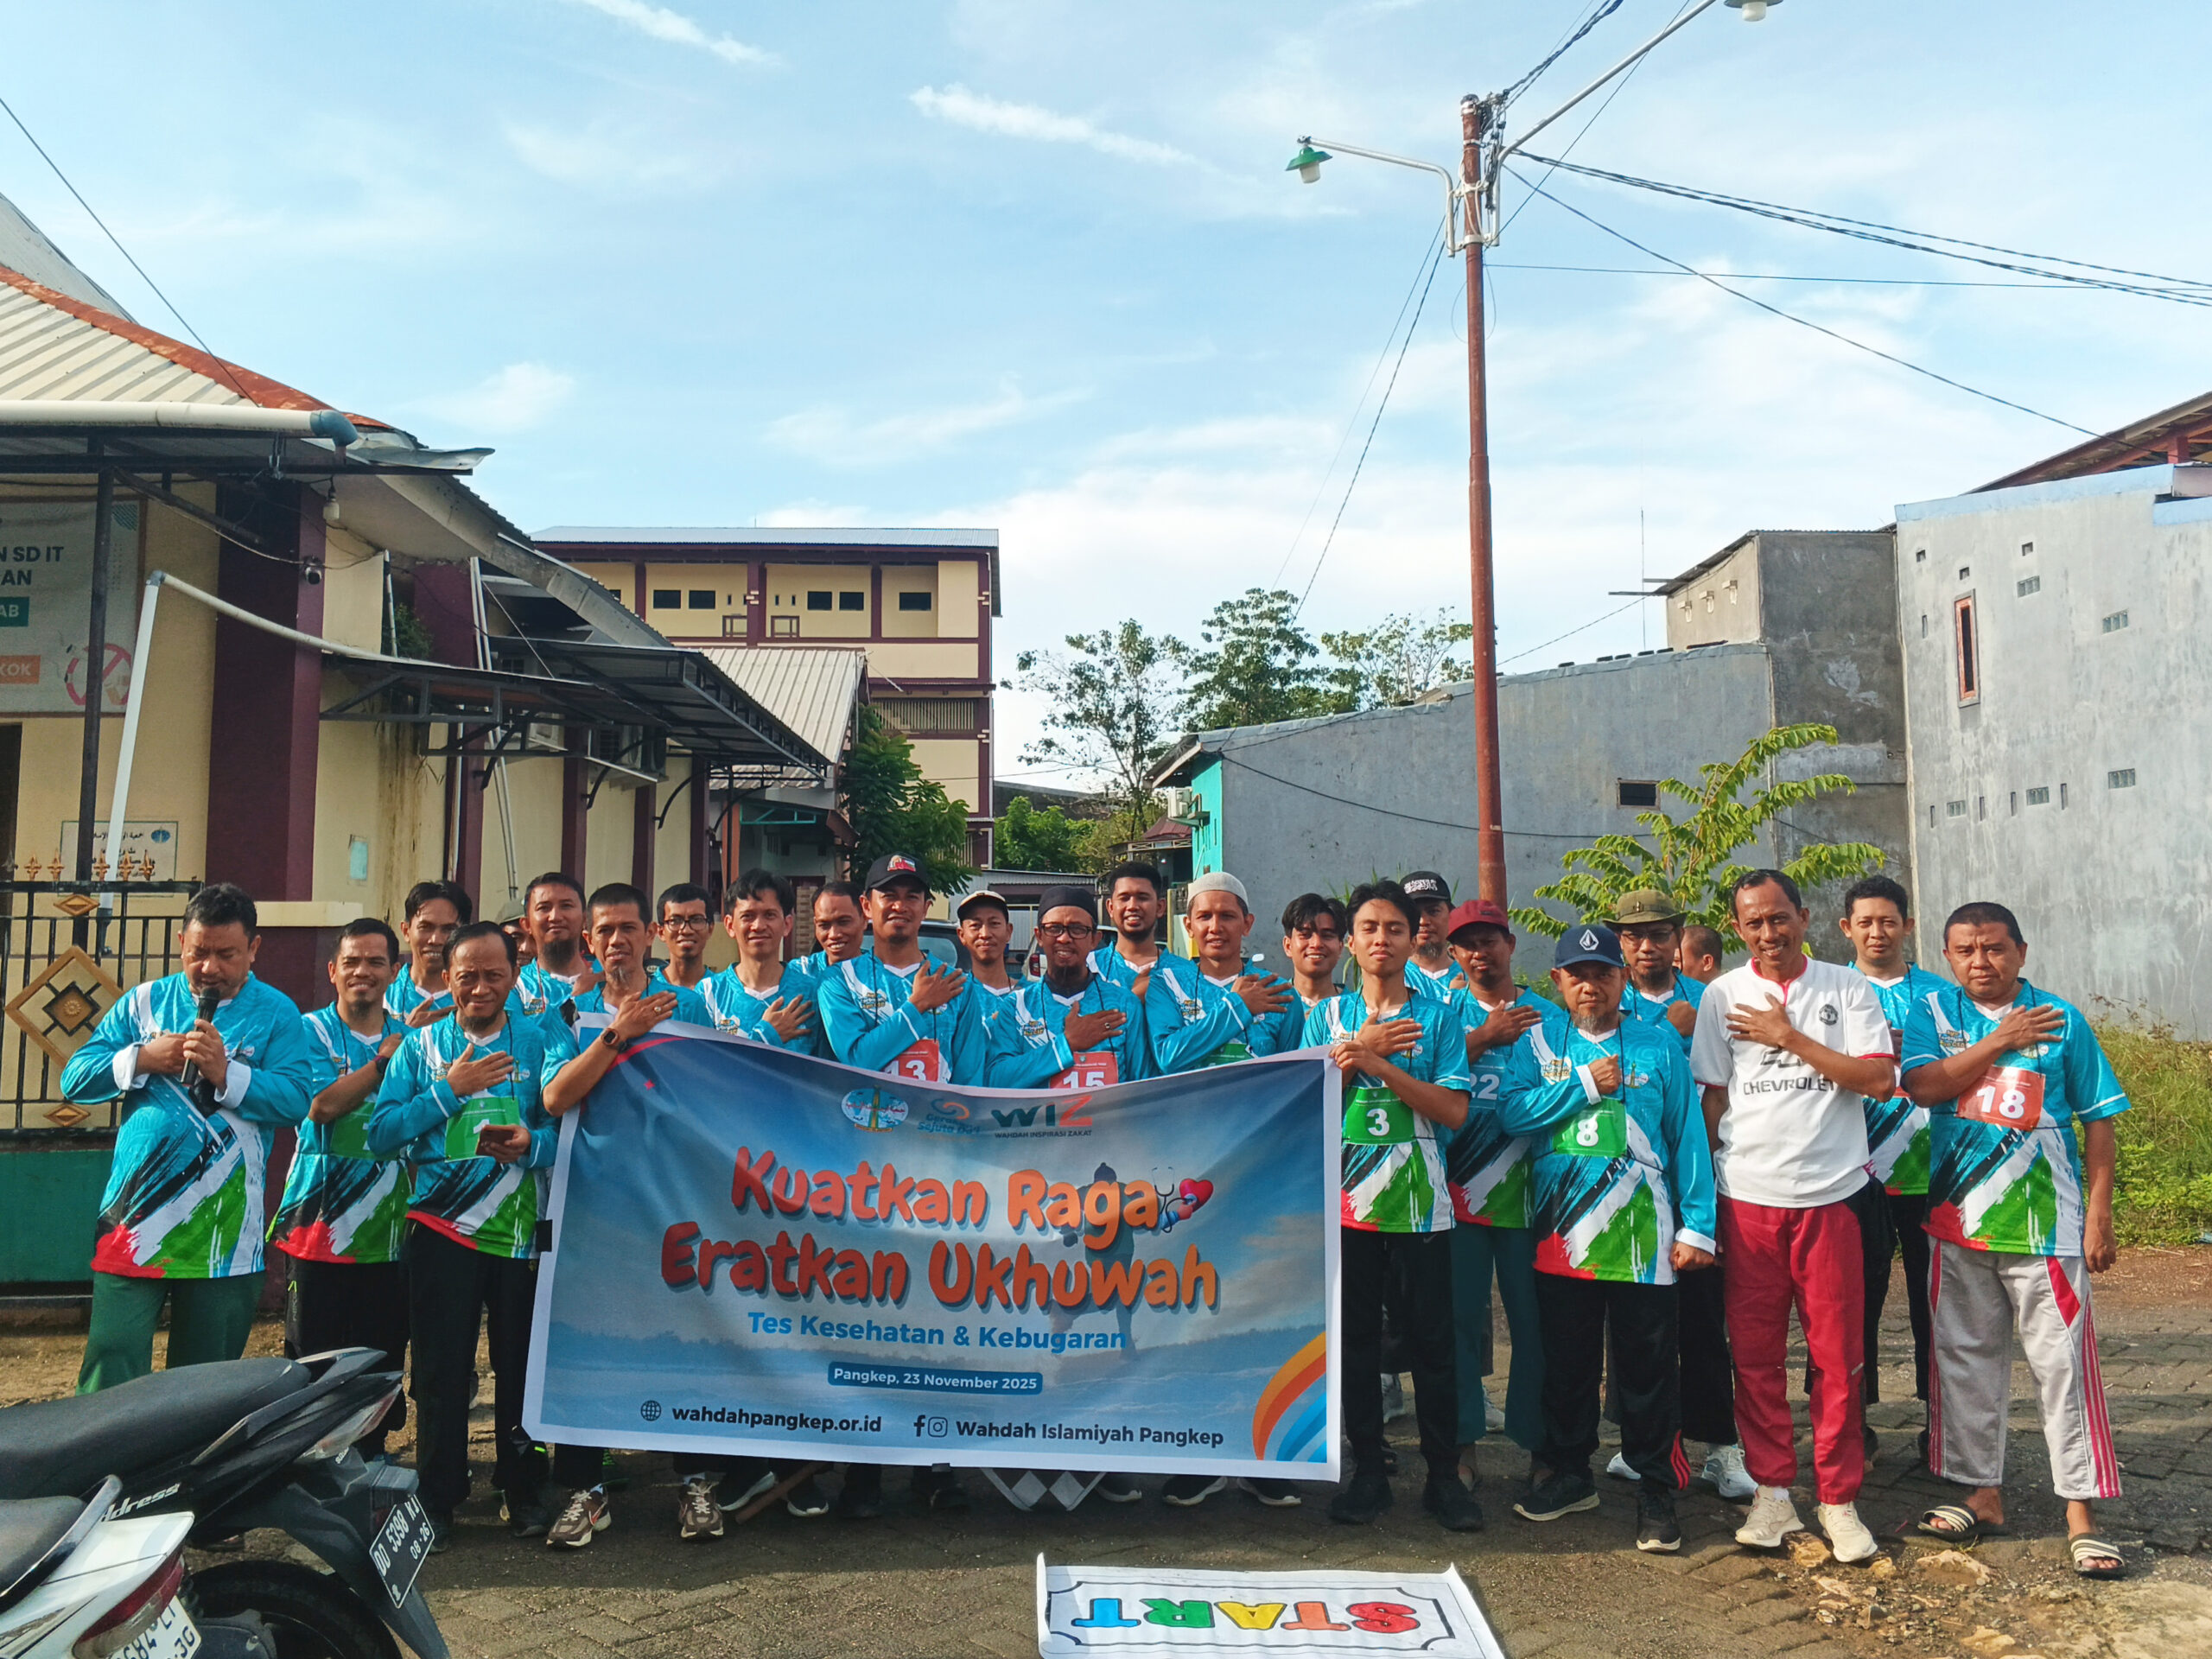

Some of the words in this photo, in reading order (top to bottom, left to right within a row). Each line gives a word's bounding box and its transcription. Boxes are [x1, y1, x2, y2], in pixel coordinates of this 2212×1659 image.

[13, 546, 41, 563] SD
[46, 546, 64, 562] IT
[991, 1095, 1093, 1128] WIZ
[1976, 1085, 2025, 1119] 18
[1365, 1109, 1389, 1136] 3
[1576, 1117, 1599, 1147] 8
[731, 1146, 988, 1225] Kuatkan
[1007, 1169, 1160, 1250] Raga
[661, 1221, 909, 1302] Eratkan
[928, 1239, 1217, 1307] Ukhuwah
[747, 1312, 792, 1334] Tes
[800, 1315, 944, 1344] Kesehatan
[953, 1326, 970, 1346] &
[979, 1326, 1127, 1354] Kebugaran
[834, 1368, 900, 1385] Pangkep,
[903, 1374, 921, 1384] 23
[924, 1375, 998, 1389] November
[1001, 1378, 1037, 1389] 2025
[671, 1406, 882, 1433] wahdahpangkep.or.id
[956, 1421, 1036, 1439] Wahdah
[1042, 1424, 1134, 1445] Islamiyah
[1140, 1427, 1224, 1448] Pangkep
[373, 1542, 391, 1577] DD
[385, 1510, 410, 1553] 5398
[1071, 1597, 1421, 1634] START
